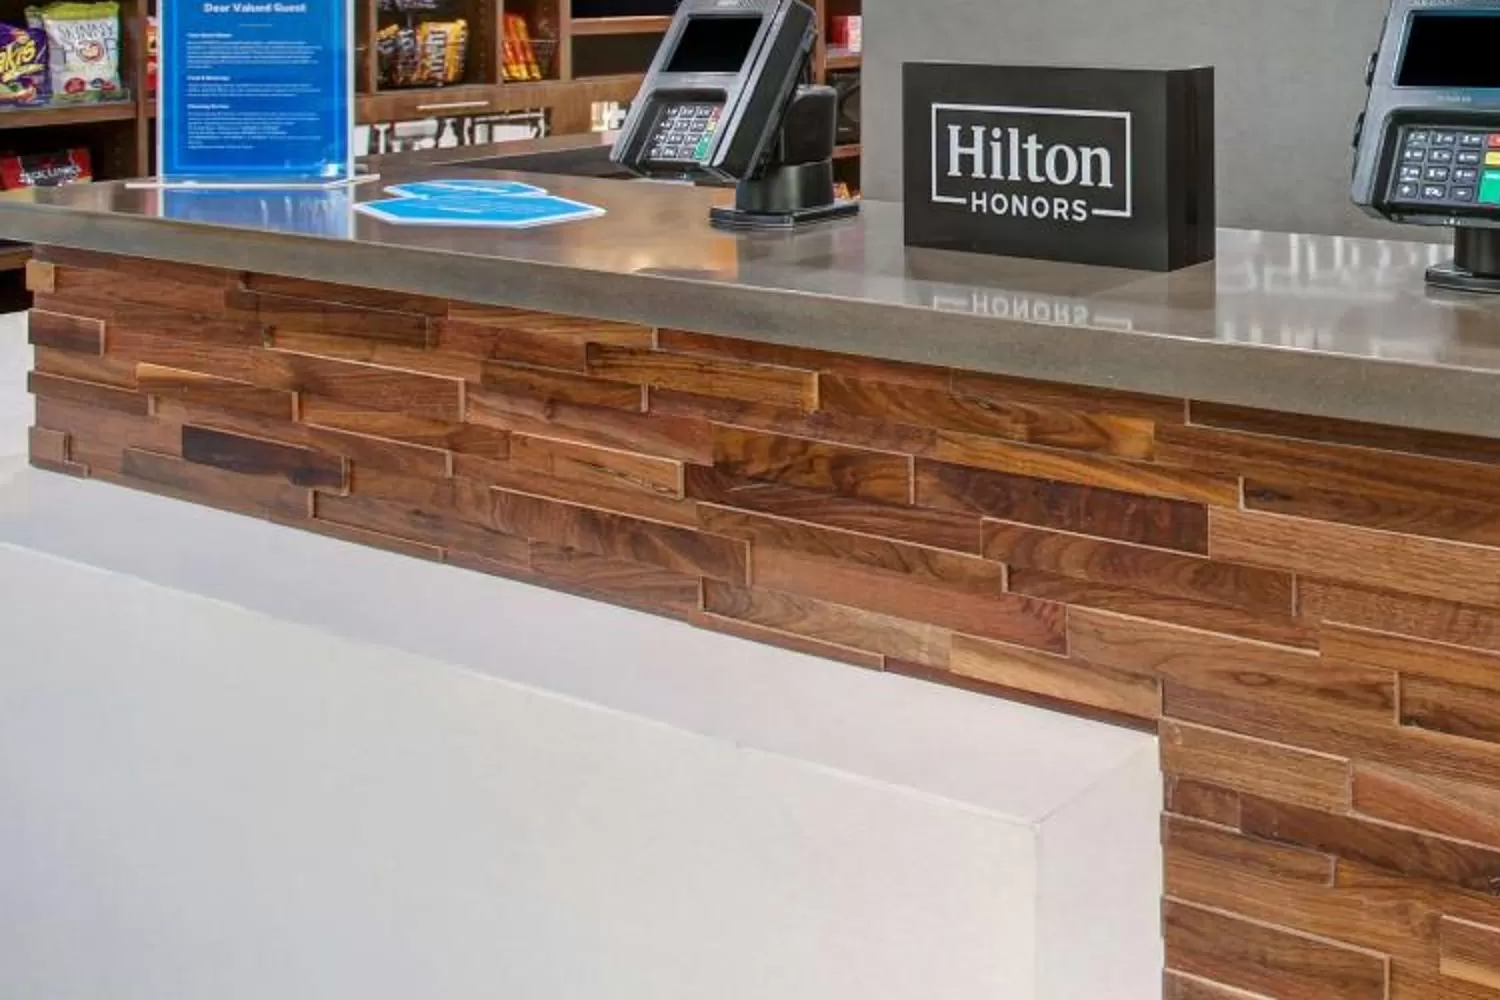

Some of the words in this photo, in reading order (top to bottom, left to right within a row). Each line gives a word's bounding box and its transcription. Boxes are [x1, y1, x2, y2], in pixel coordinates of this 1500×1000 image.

[203, 3, 230, 13] Dear
[274, 3, 307, 13] Guest
[0, 40, 37, 74] akis
[947, 124, 1114, 188] Hilton
[971, 192, 1088, 222] HONORS
